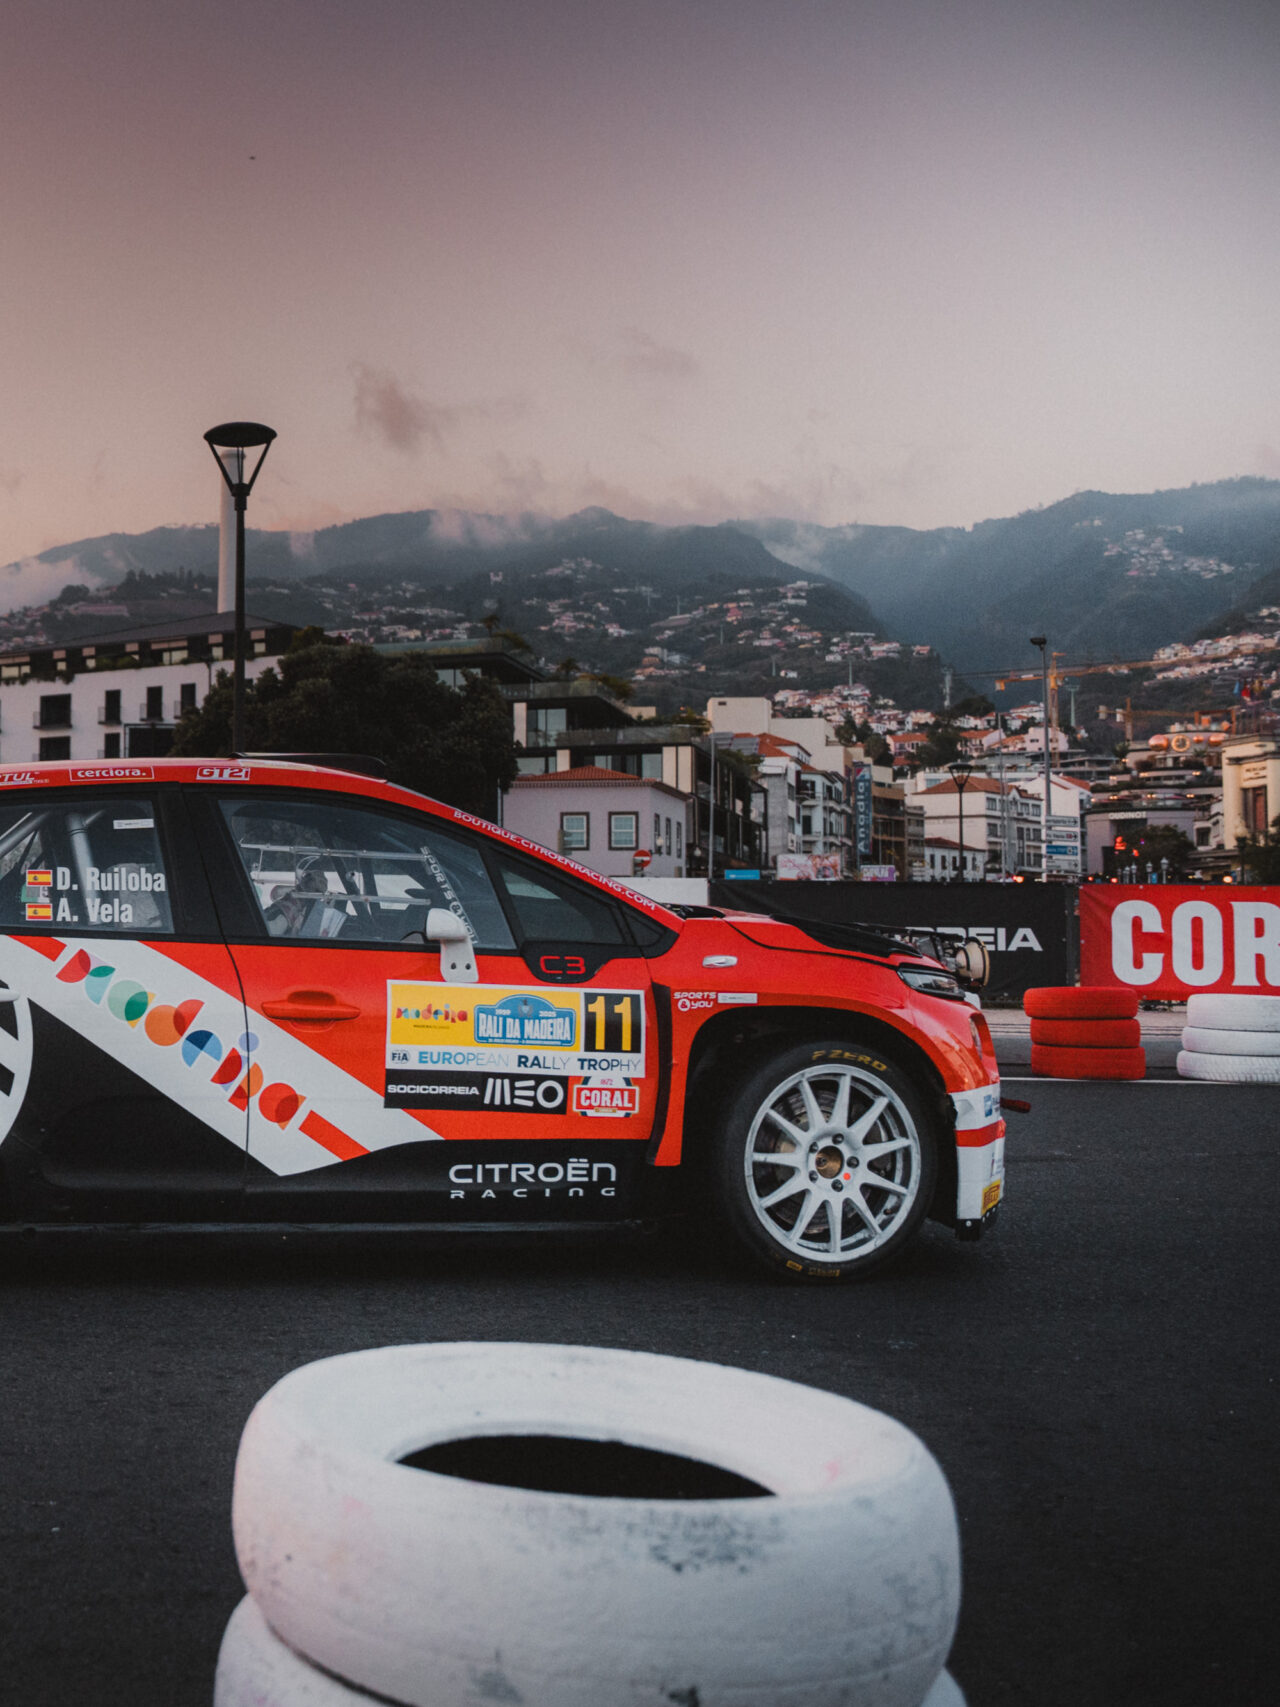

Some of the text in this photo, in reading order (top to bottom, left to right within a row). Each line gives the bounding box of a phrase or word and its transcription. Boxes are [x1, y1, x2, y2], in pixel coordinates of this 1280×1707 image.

[77, 766, 147, 778] cerciora.
[56, 867, 79, 892] D.
[87, 867, 166, 892] Ruiloba
[56, 898, 133, 923] A. Vela
[540, 955, 586, 974] C3
[674, 991, 716, 999] SPORTS
[691, 1000, 713, 1009] YOU
[478, 1013, 571, 1042] RALI DA MADEIRA
[588, 996, 632, 1051] 11
[418, 1051, 509, 1067] EUROPEAN
[517, 1055, 569, 1069] RALLY
[577, 1057, 641, 1071] TROPHY
[387, 1077, 564, 1108] SOCICORREIA MEO
[580, 1089, 633, 1108] CORAL
[449, 1187, 616, 1199] RACING
